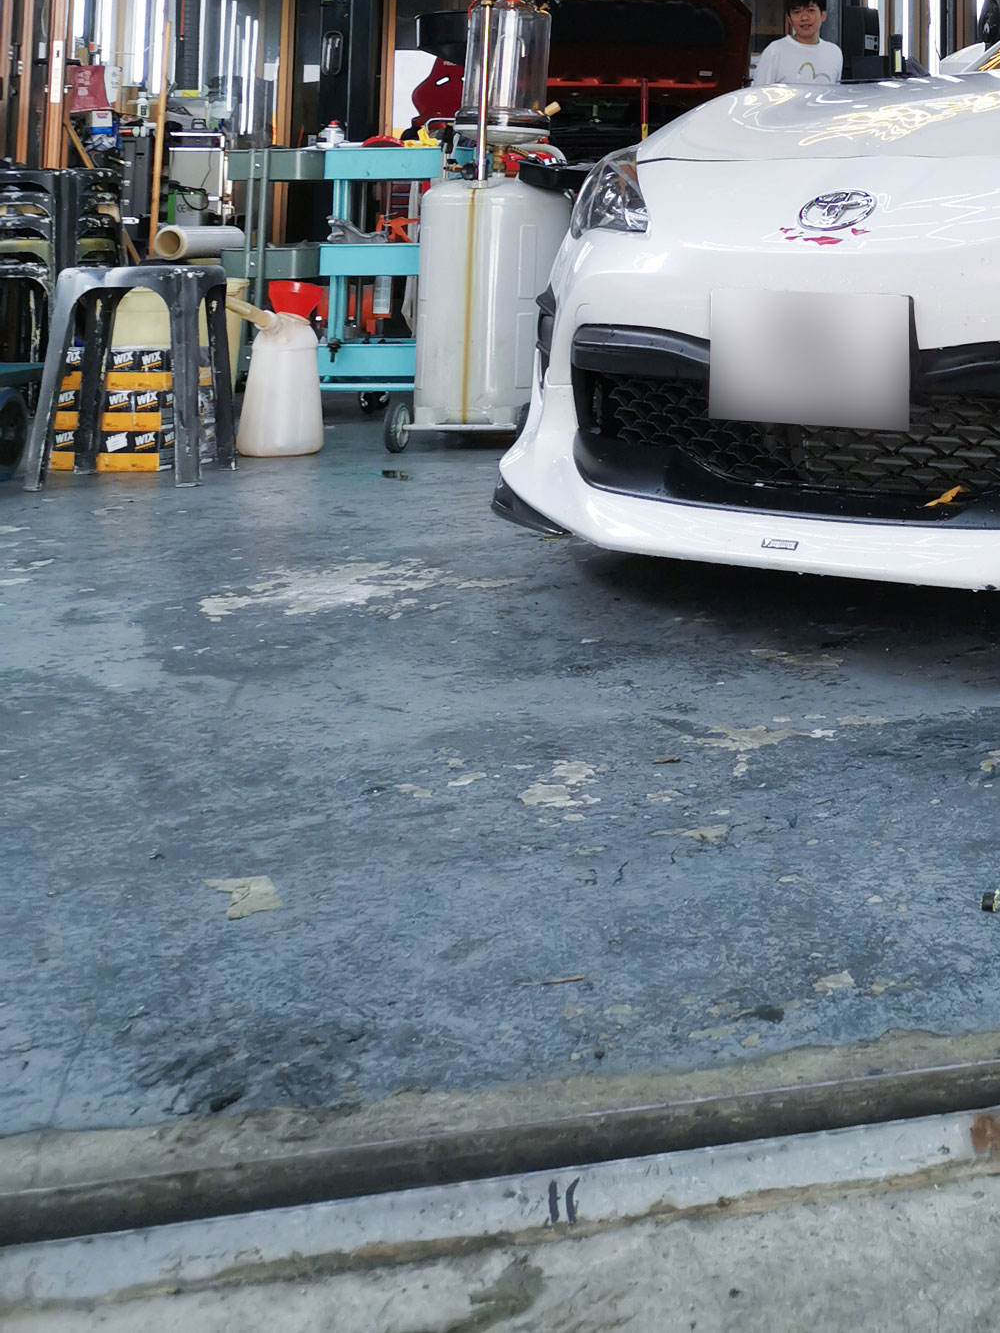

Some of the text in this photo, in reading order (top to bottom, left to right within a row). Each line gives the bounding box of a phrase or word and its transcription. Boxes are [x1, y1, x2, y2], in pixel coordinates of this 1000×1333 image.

[113, 351, 134, 365] WIX
[142, 351, 162, 365] WIX
[109, 392, 129, 405] WIX
[137, 391, 158, 405] WIX
[55, 431, 75, 444] WIX
[135, 432, 156, 446] WIX
